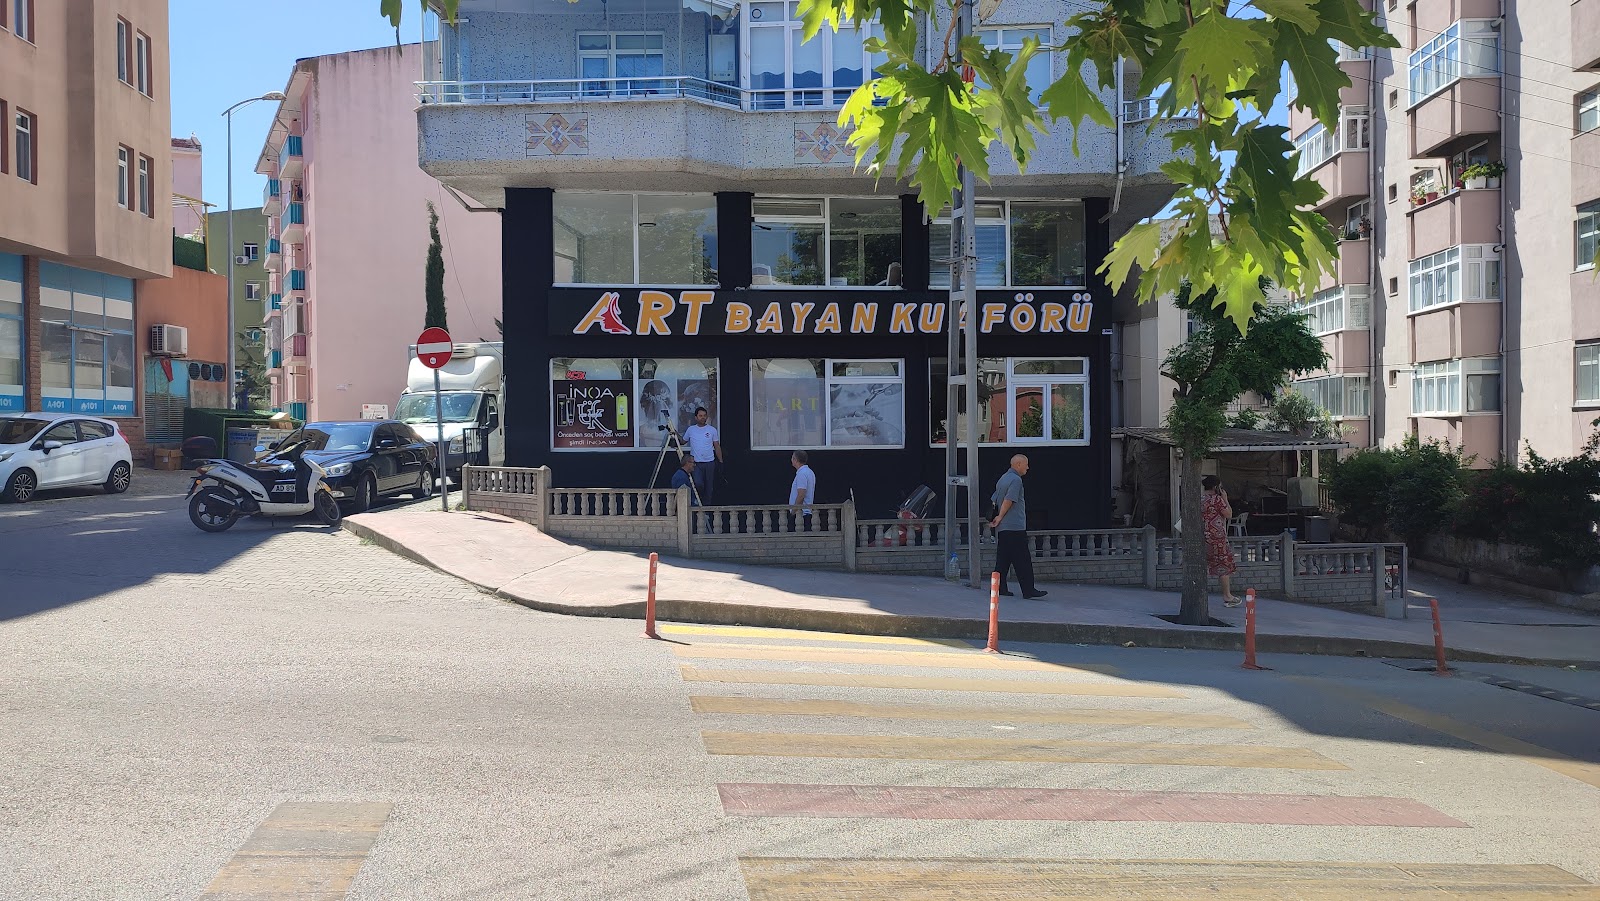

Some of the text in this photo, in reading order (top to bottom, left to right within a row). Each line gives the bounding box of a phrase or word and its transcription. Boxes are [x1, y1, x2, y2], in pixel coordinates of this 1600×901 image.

[572, 291, 716, 336] ART
[724, 302, 879, 334] BAYAN
[774, 398, 819, 411] ART
